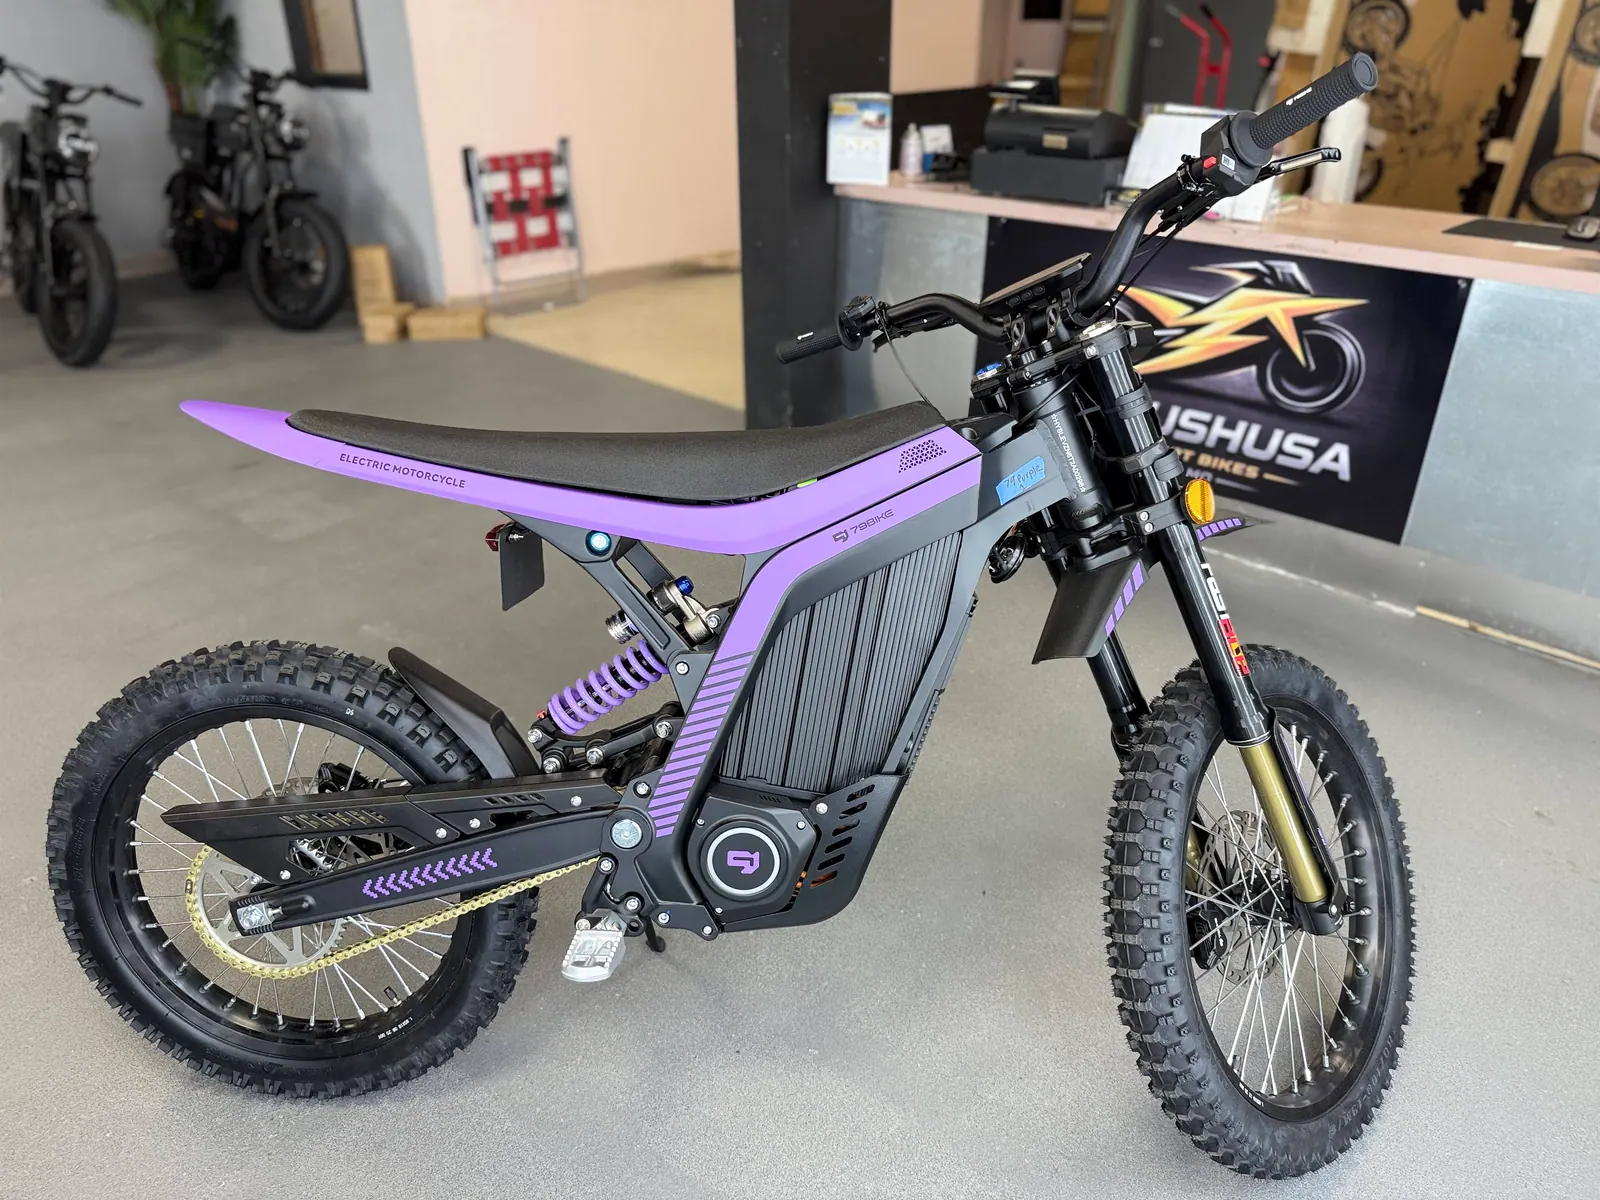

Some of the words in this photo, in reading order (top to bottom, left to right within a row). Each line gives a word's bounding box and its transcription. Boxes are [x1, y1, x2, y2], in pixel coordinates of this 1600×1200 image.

[1152, 401, 1351, 482] USHUSA
[339, 453, 391, 471] ELECTRIC
[392, 465, 466, 488] MOTORCYCLE
[1197, 453, 1260, 479] BIKES
[850, 509, 894, 534] 79BIKE
